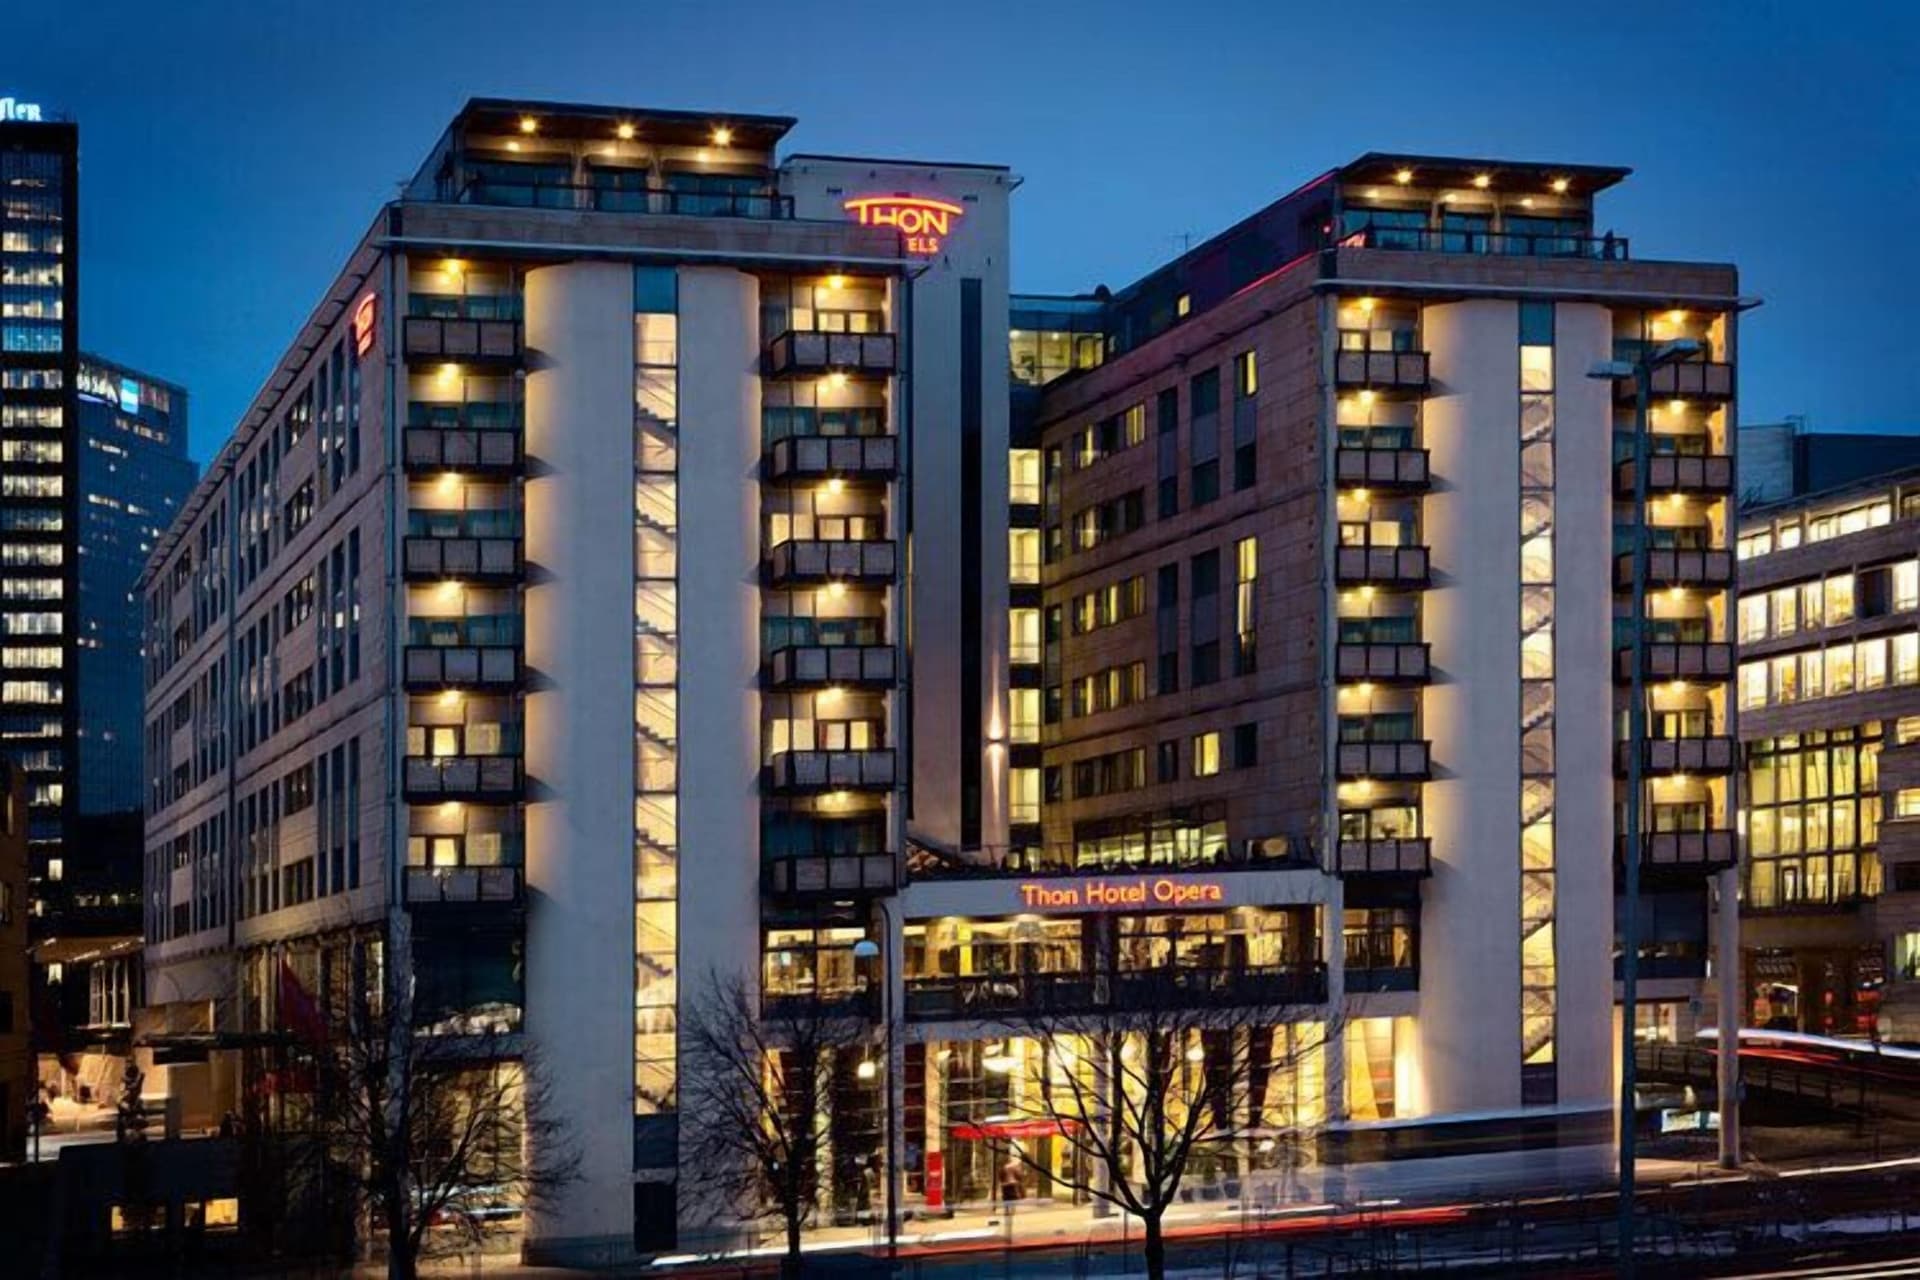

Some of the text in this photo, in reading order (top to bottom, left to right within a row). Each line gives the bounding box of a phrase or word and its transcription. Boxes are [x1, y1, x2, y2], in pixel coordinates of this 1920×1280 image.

[844, 197, 964, 235] THON
[907, 237, 939, 254] ELS
[1021, 880, 1222, 906] Thon Hotel Opera
